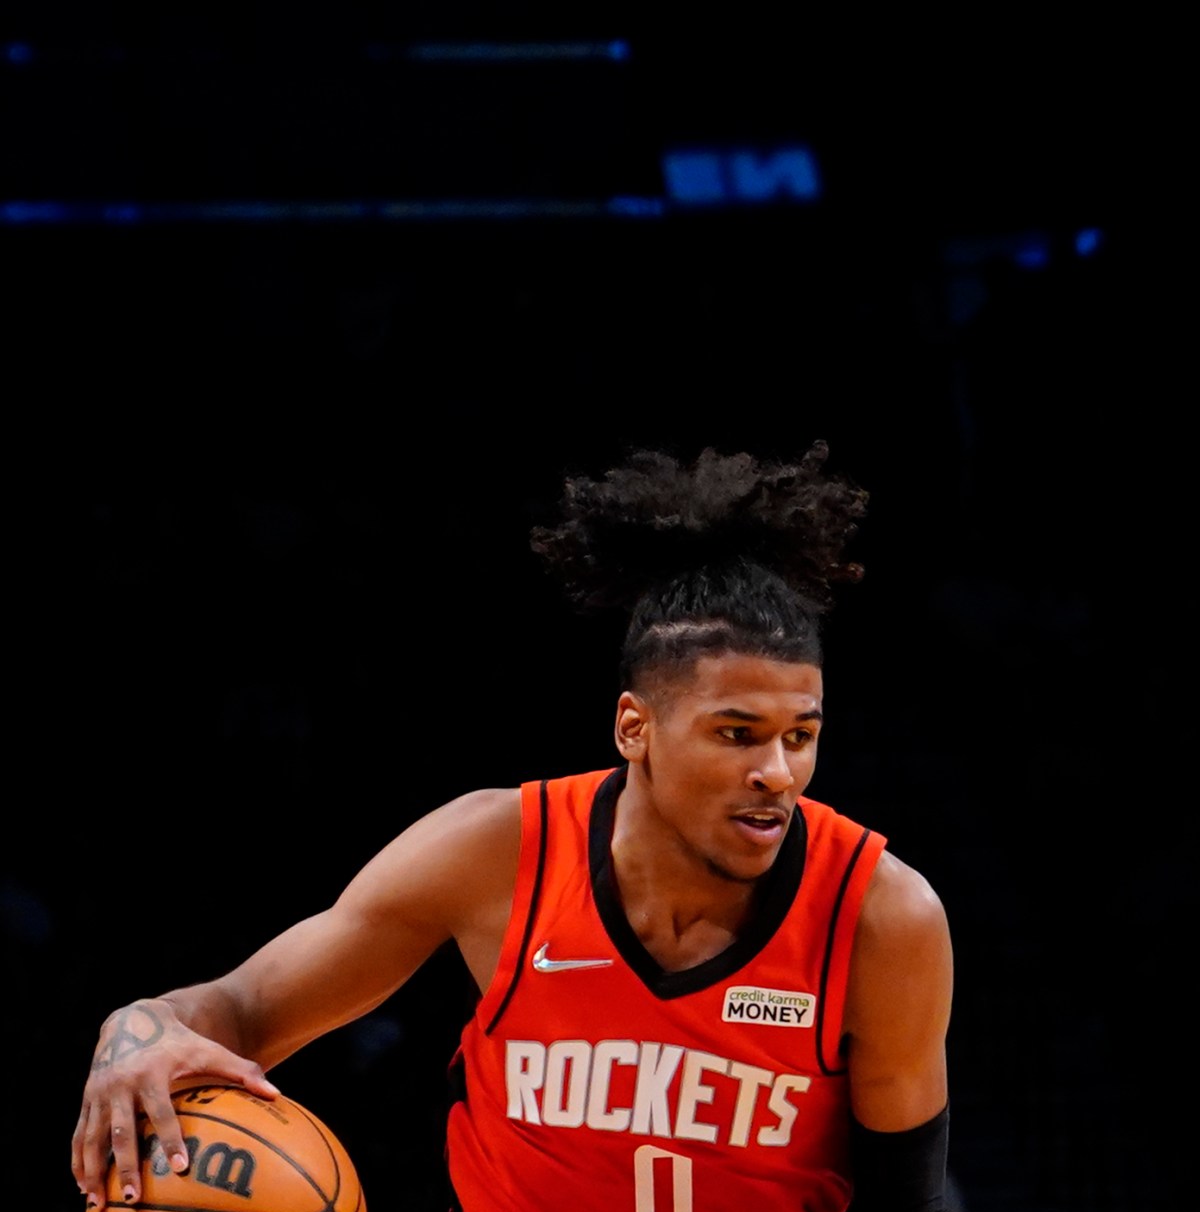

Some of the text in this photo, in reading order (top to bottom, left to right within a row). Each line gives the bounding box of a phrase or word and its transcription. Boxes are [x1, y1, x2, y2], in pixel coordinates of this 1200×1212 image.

[729, 990, 810, 1007] credit karma
[727, 1002, 808, 1024] MONEY
[505, 1039, 812, 1148] ROCKETS
